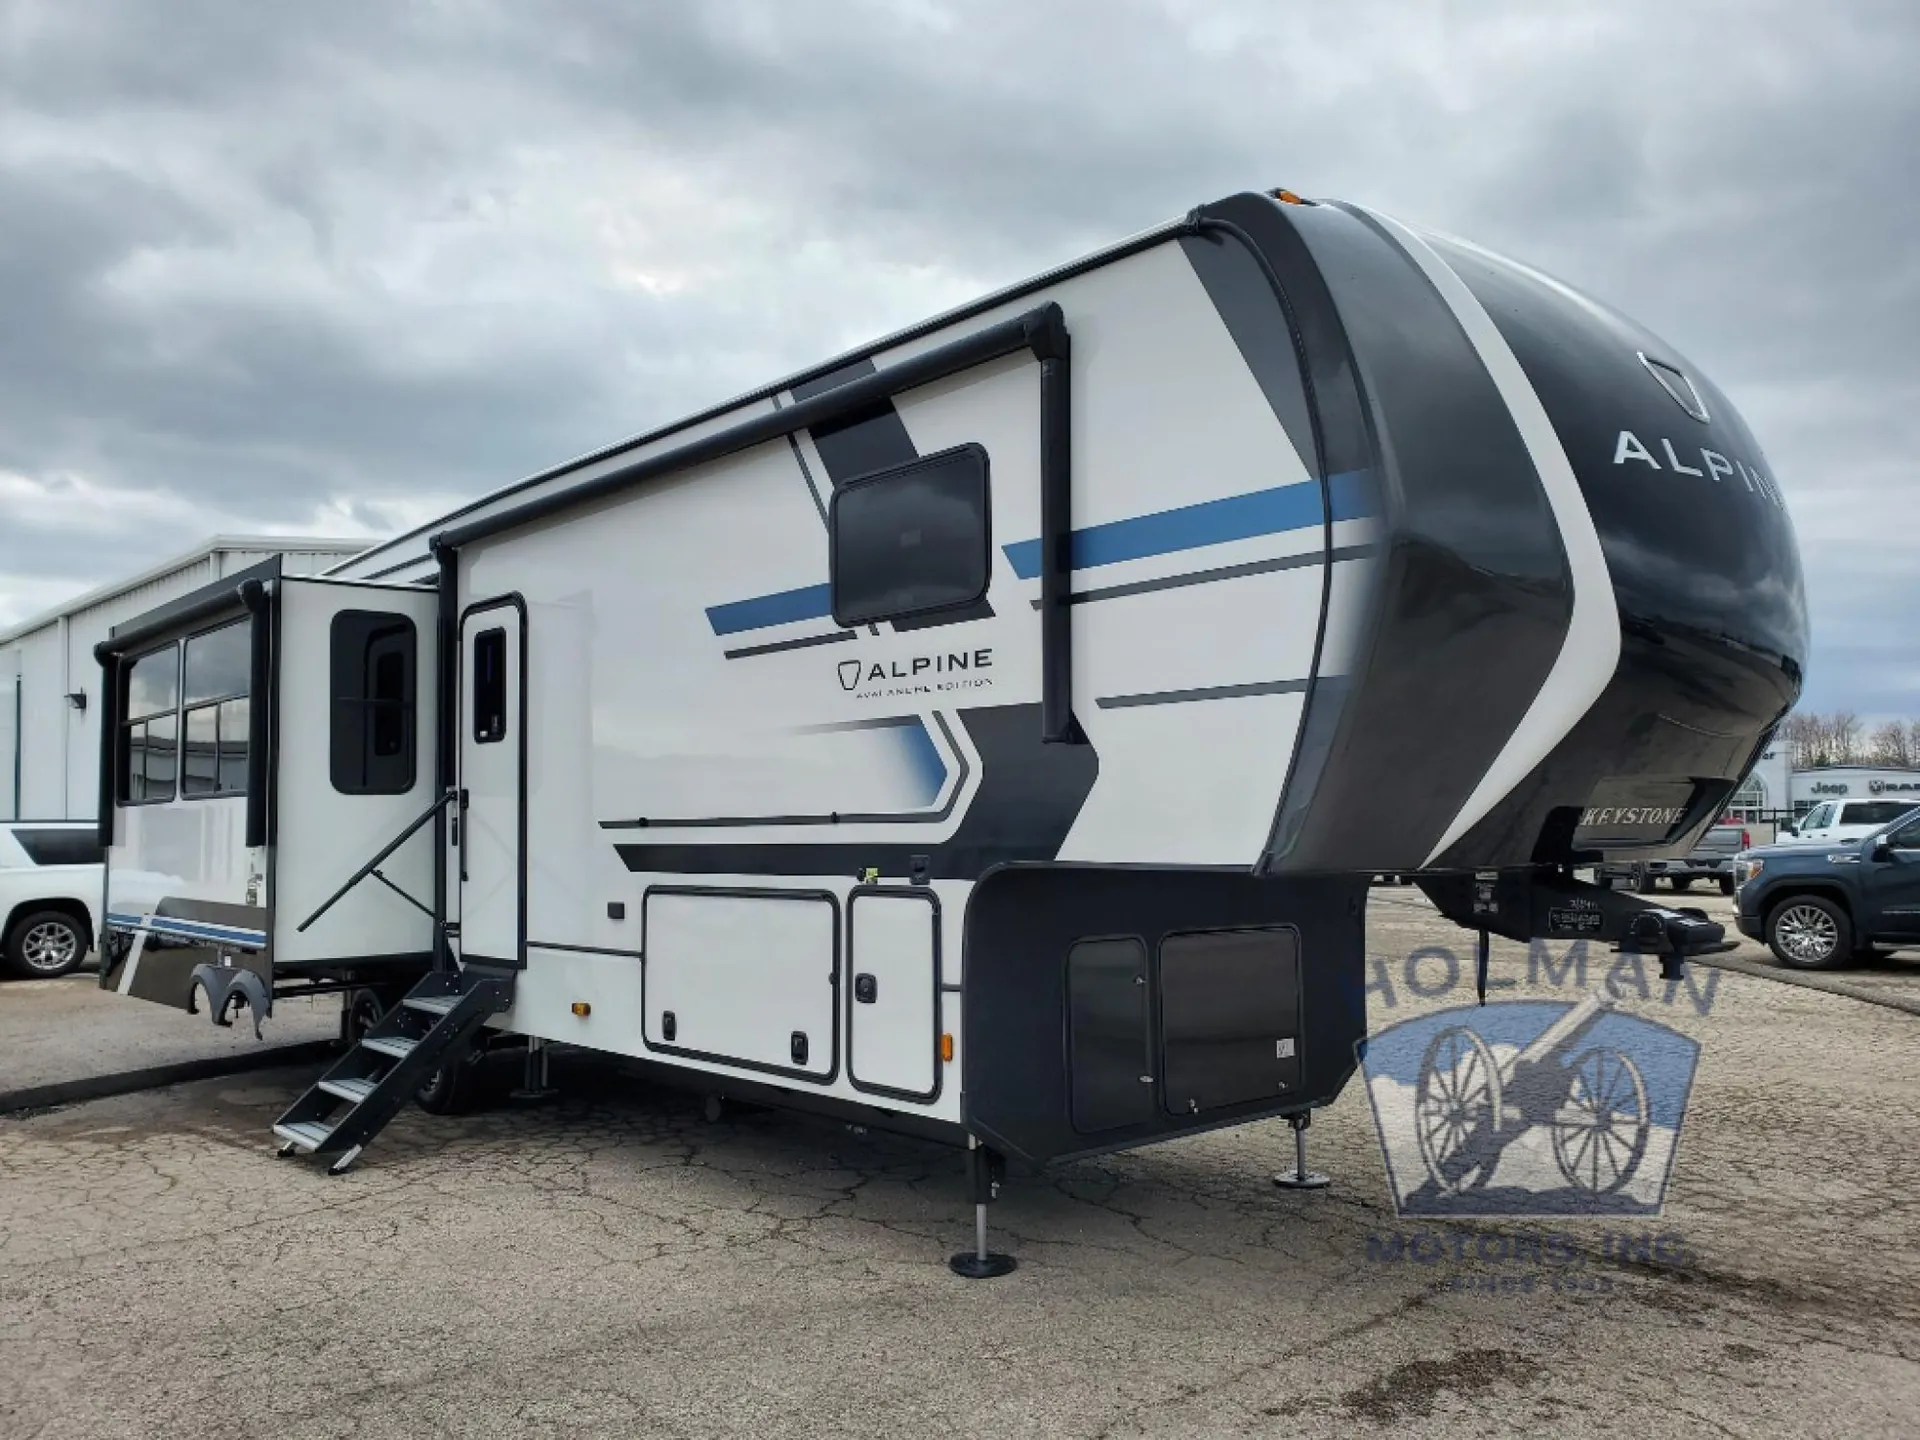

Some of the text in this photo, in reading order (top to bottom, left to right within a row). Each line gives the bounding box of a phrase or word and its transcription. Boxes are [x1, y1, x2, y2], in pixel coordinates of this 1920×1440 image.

[1613, 430, 1786, 510] ALPIN
[867, 648, 993, 681] ALPINE
[1811, 782, 1848, 795] Jeep
[1580, 807, 1688, 826] KEYSTONE
